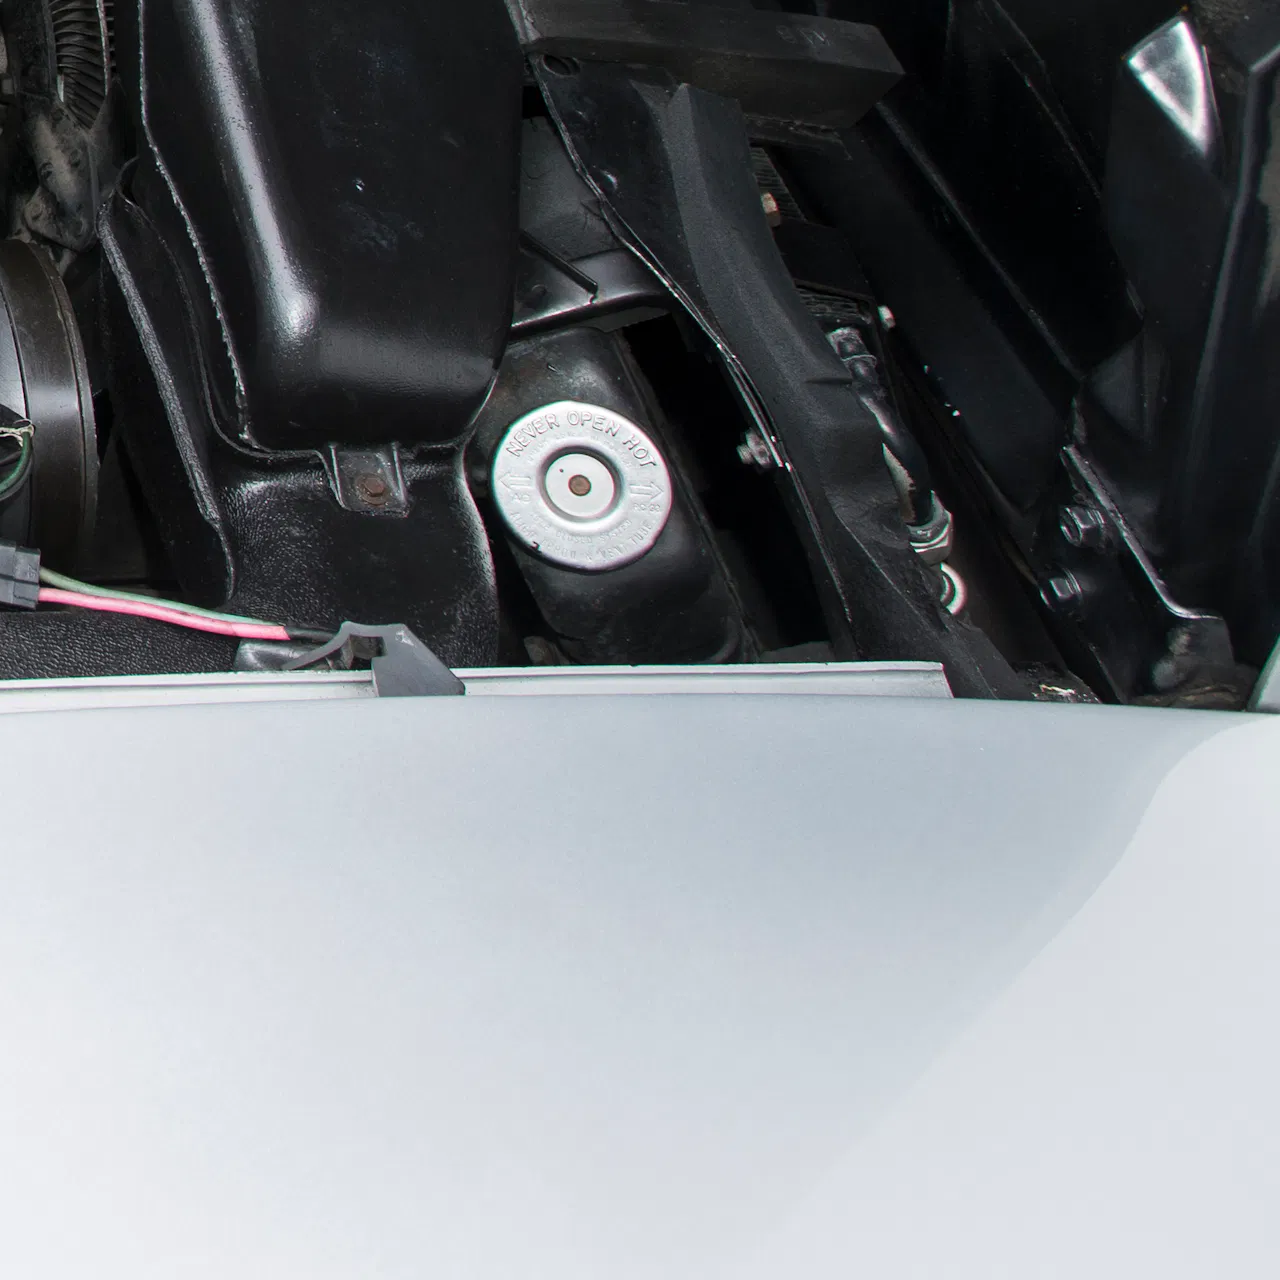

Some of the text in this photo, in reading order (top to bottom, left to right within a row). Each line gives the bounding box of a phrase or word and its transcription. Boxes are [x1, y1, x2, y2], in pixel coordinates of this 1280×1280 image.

[506, 413, 560, 457] NEVER
[567, 411, 621, 437] OPEN
[623, 435, 657, 468] HOT
